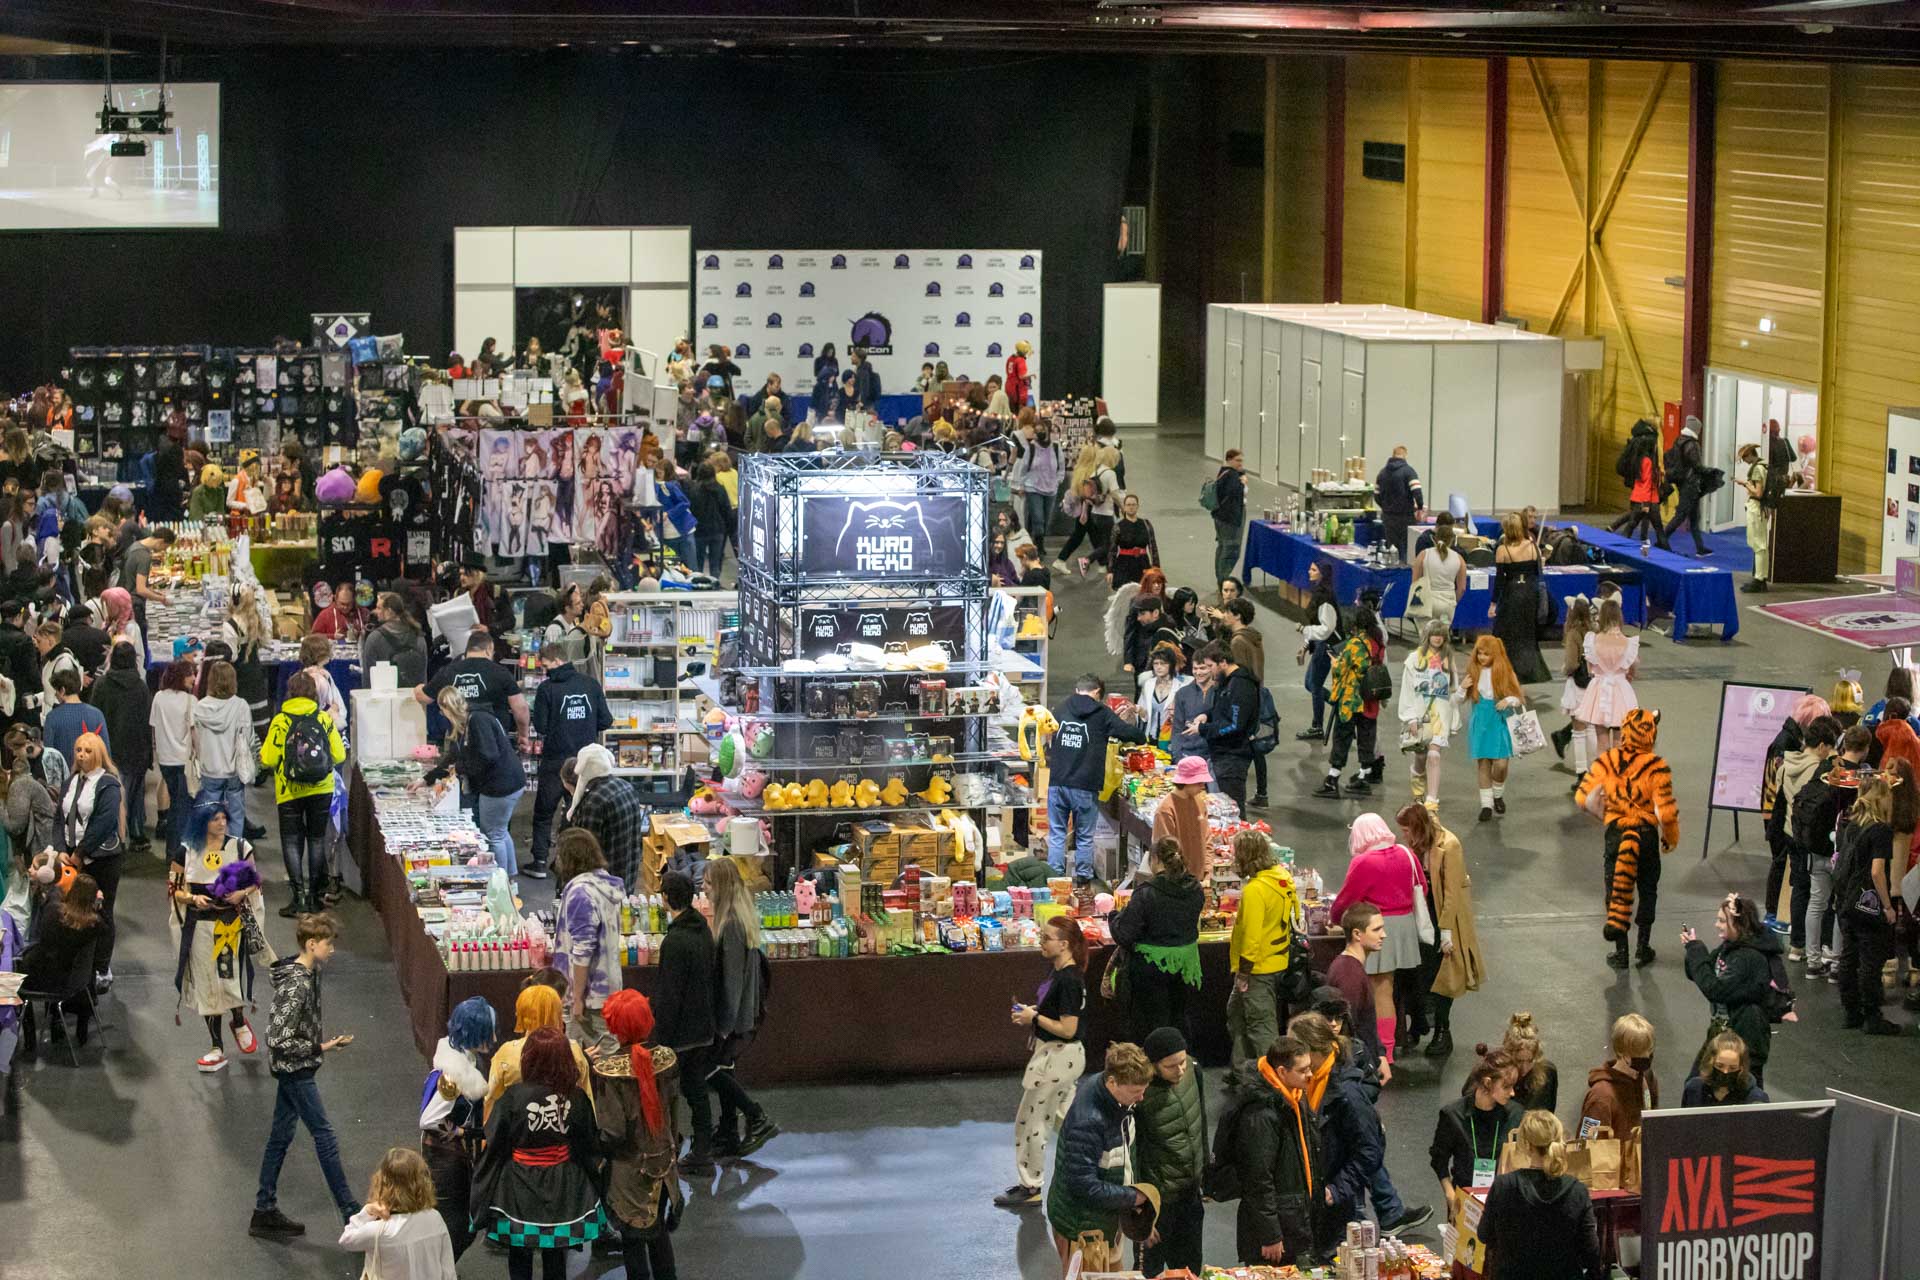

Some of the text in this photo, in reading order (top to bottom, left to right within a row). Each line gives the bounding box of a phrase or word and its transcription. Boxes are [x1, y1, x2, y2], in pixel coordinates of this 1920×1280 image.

[370, 538, 391, 558] R
[856, 536, 912, 554] KURO
[856, 554, 912, 571] NEKO
[1061, 740, 1082, 748] NEKO
[1062, 733, 1083, 742] KURO
[1657, 1232, 1814, 1280] HOBBYSHOP
